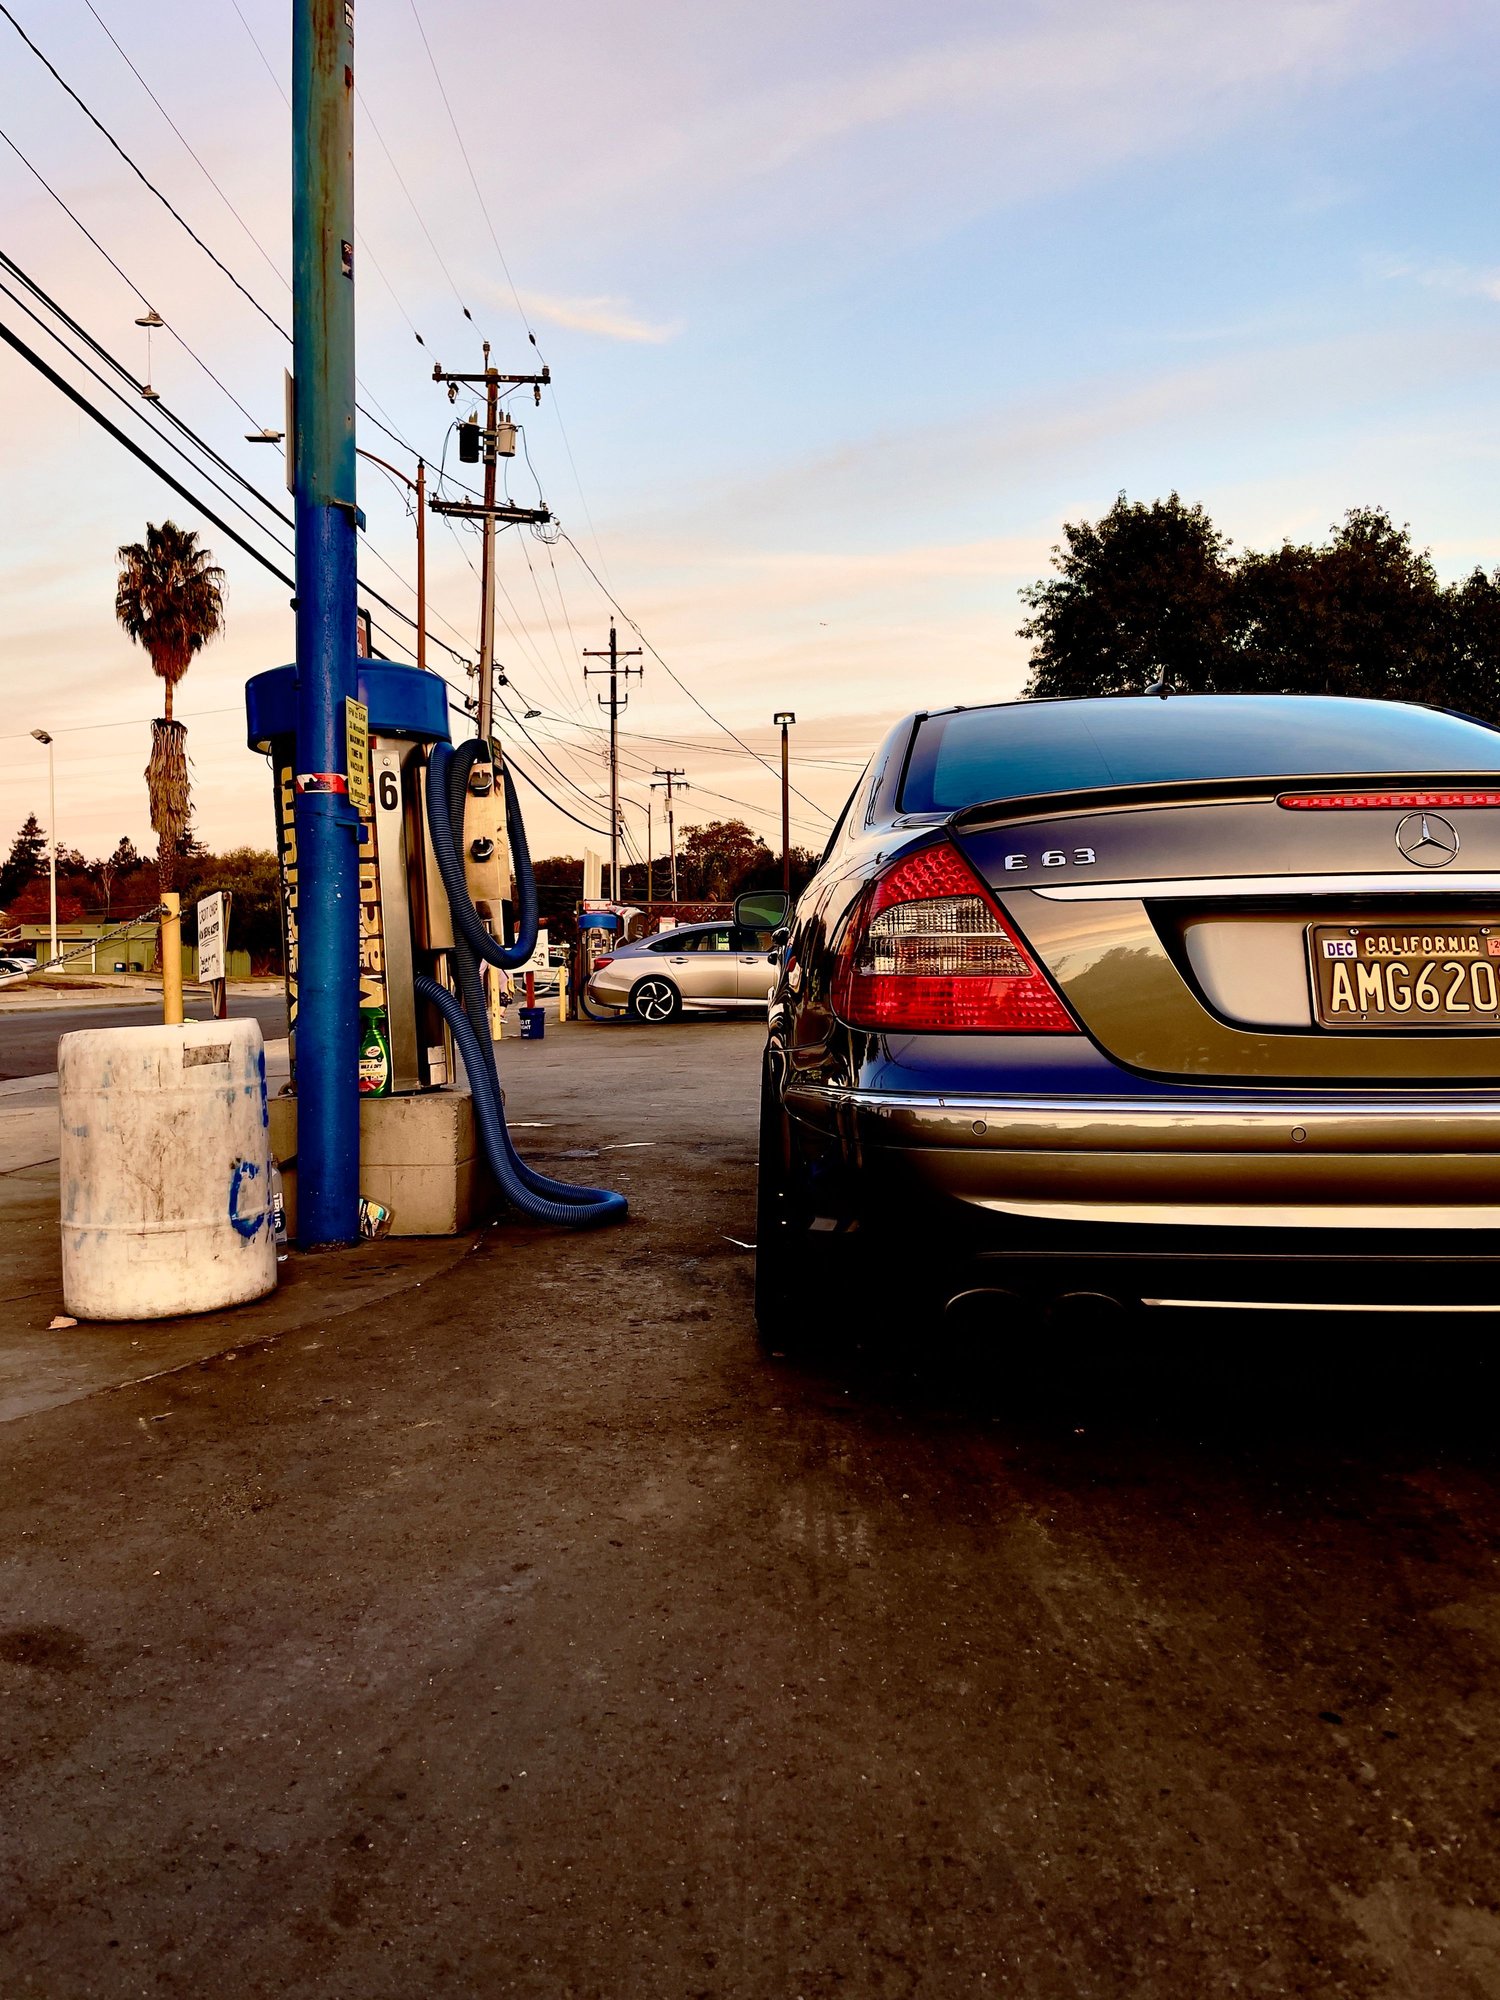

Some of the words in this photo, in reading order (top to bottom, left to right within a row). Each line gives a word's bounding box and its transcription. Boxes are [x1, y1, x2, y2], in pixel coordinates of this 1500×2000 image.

[379, 771, 398, 811] 6
[1004, 854, 1028, 871] E
[1041, 847, 1096, 867] 63
[1327, 942, 1354, 956] DEC
[1364, 936, 1480, 954] CALIFORNIA
[1331, 961, 1498, 1012] AMG620
